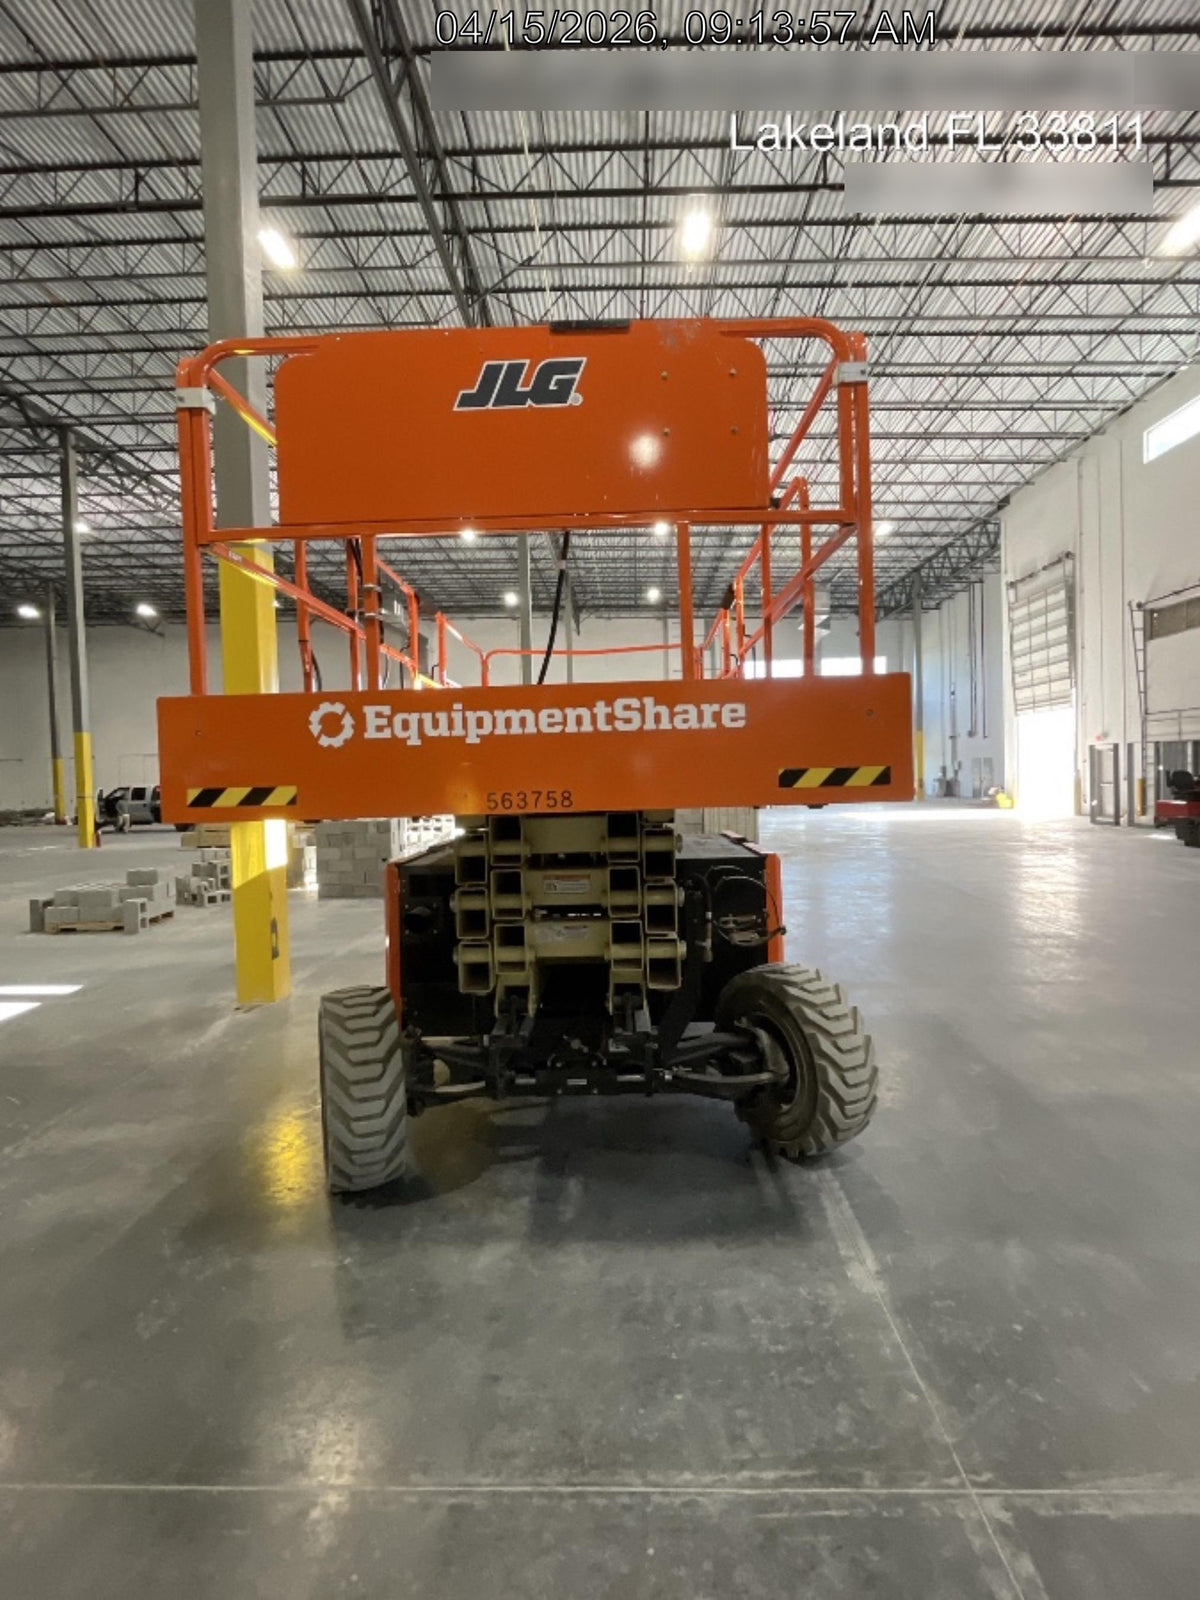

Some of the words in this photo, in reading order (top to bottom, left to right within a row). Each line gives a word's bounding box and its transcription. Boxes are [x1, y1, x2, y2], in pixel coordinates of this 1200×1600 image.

[453, 357, 587, 411] JLG
[363, 696, 747, 746] EquipmentShare
[486, 790, 573, 811] 563758
